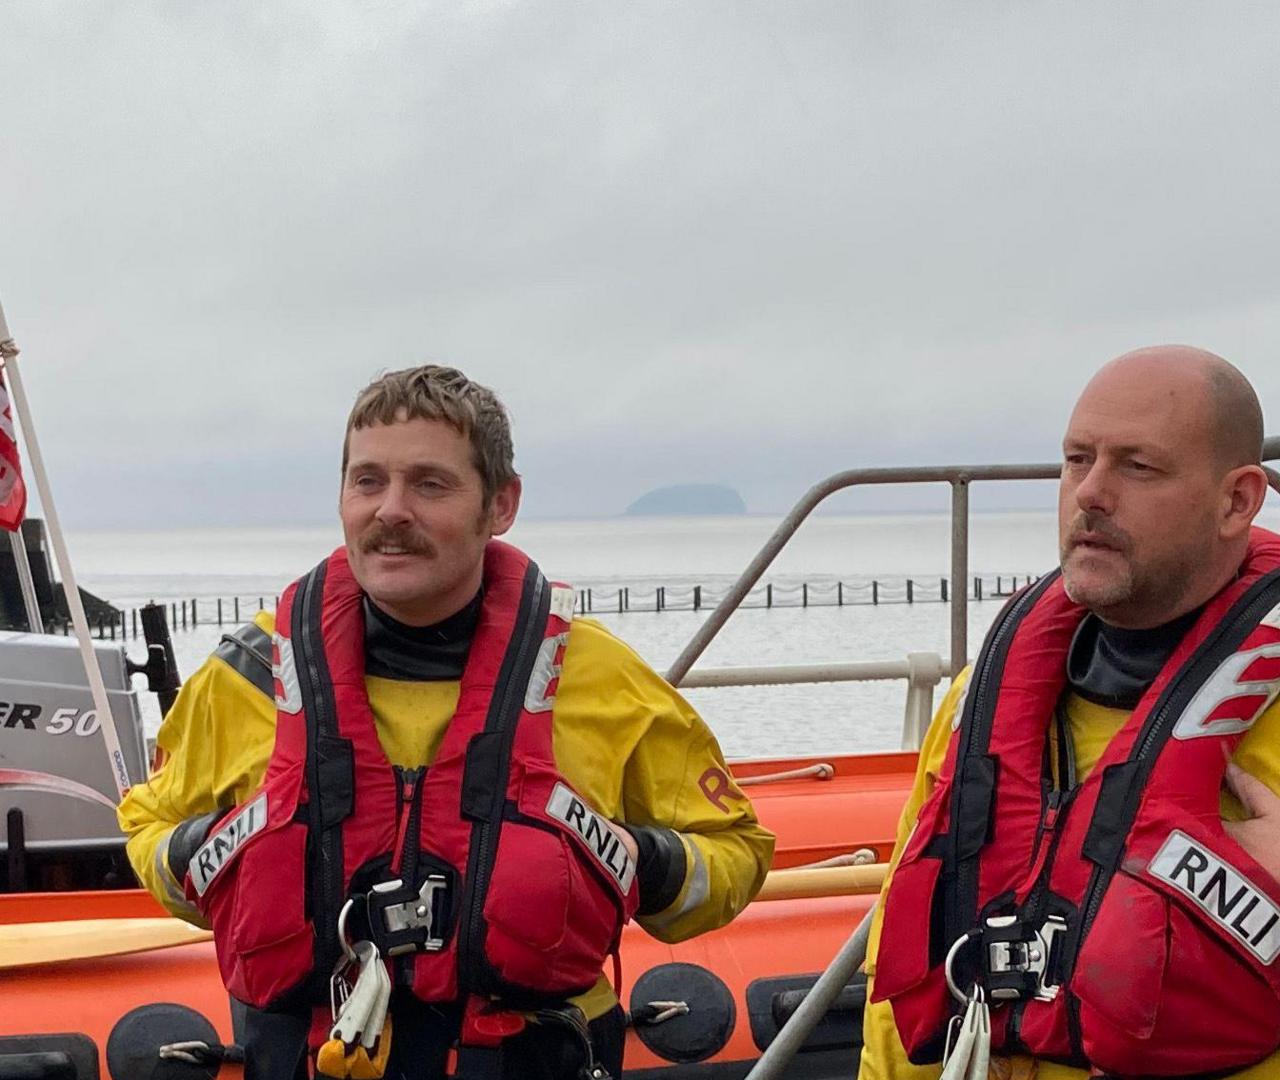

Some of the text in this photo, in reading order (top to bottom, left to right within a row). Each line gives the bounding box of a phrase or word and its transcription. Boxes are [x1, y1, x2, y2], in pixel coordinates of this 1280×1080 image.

[45, 707, 101, 737] 50
[565, 796, 629, 881] RNLI
[1169, 846, 1280, 948] RNLI
